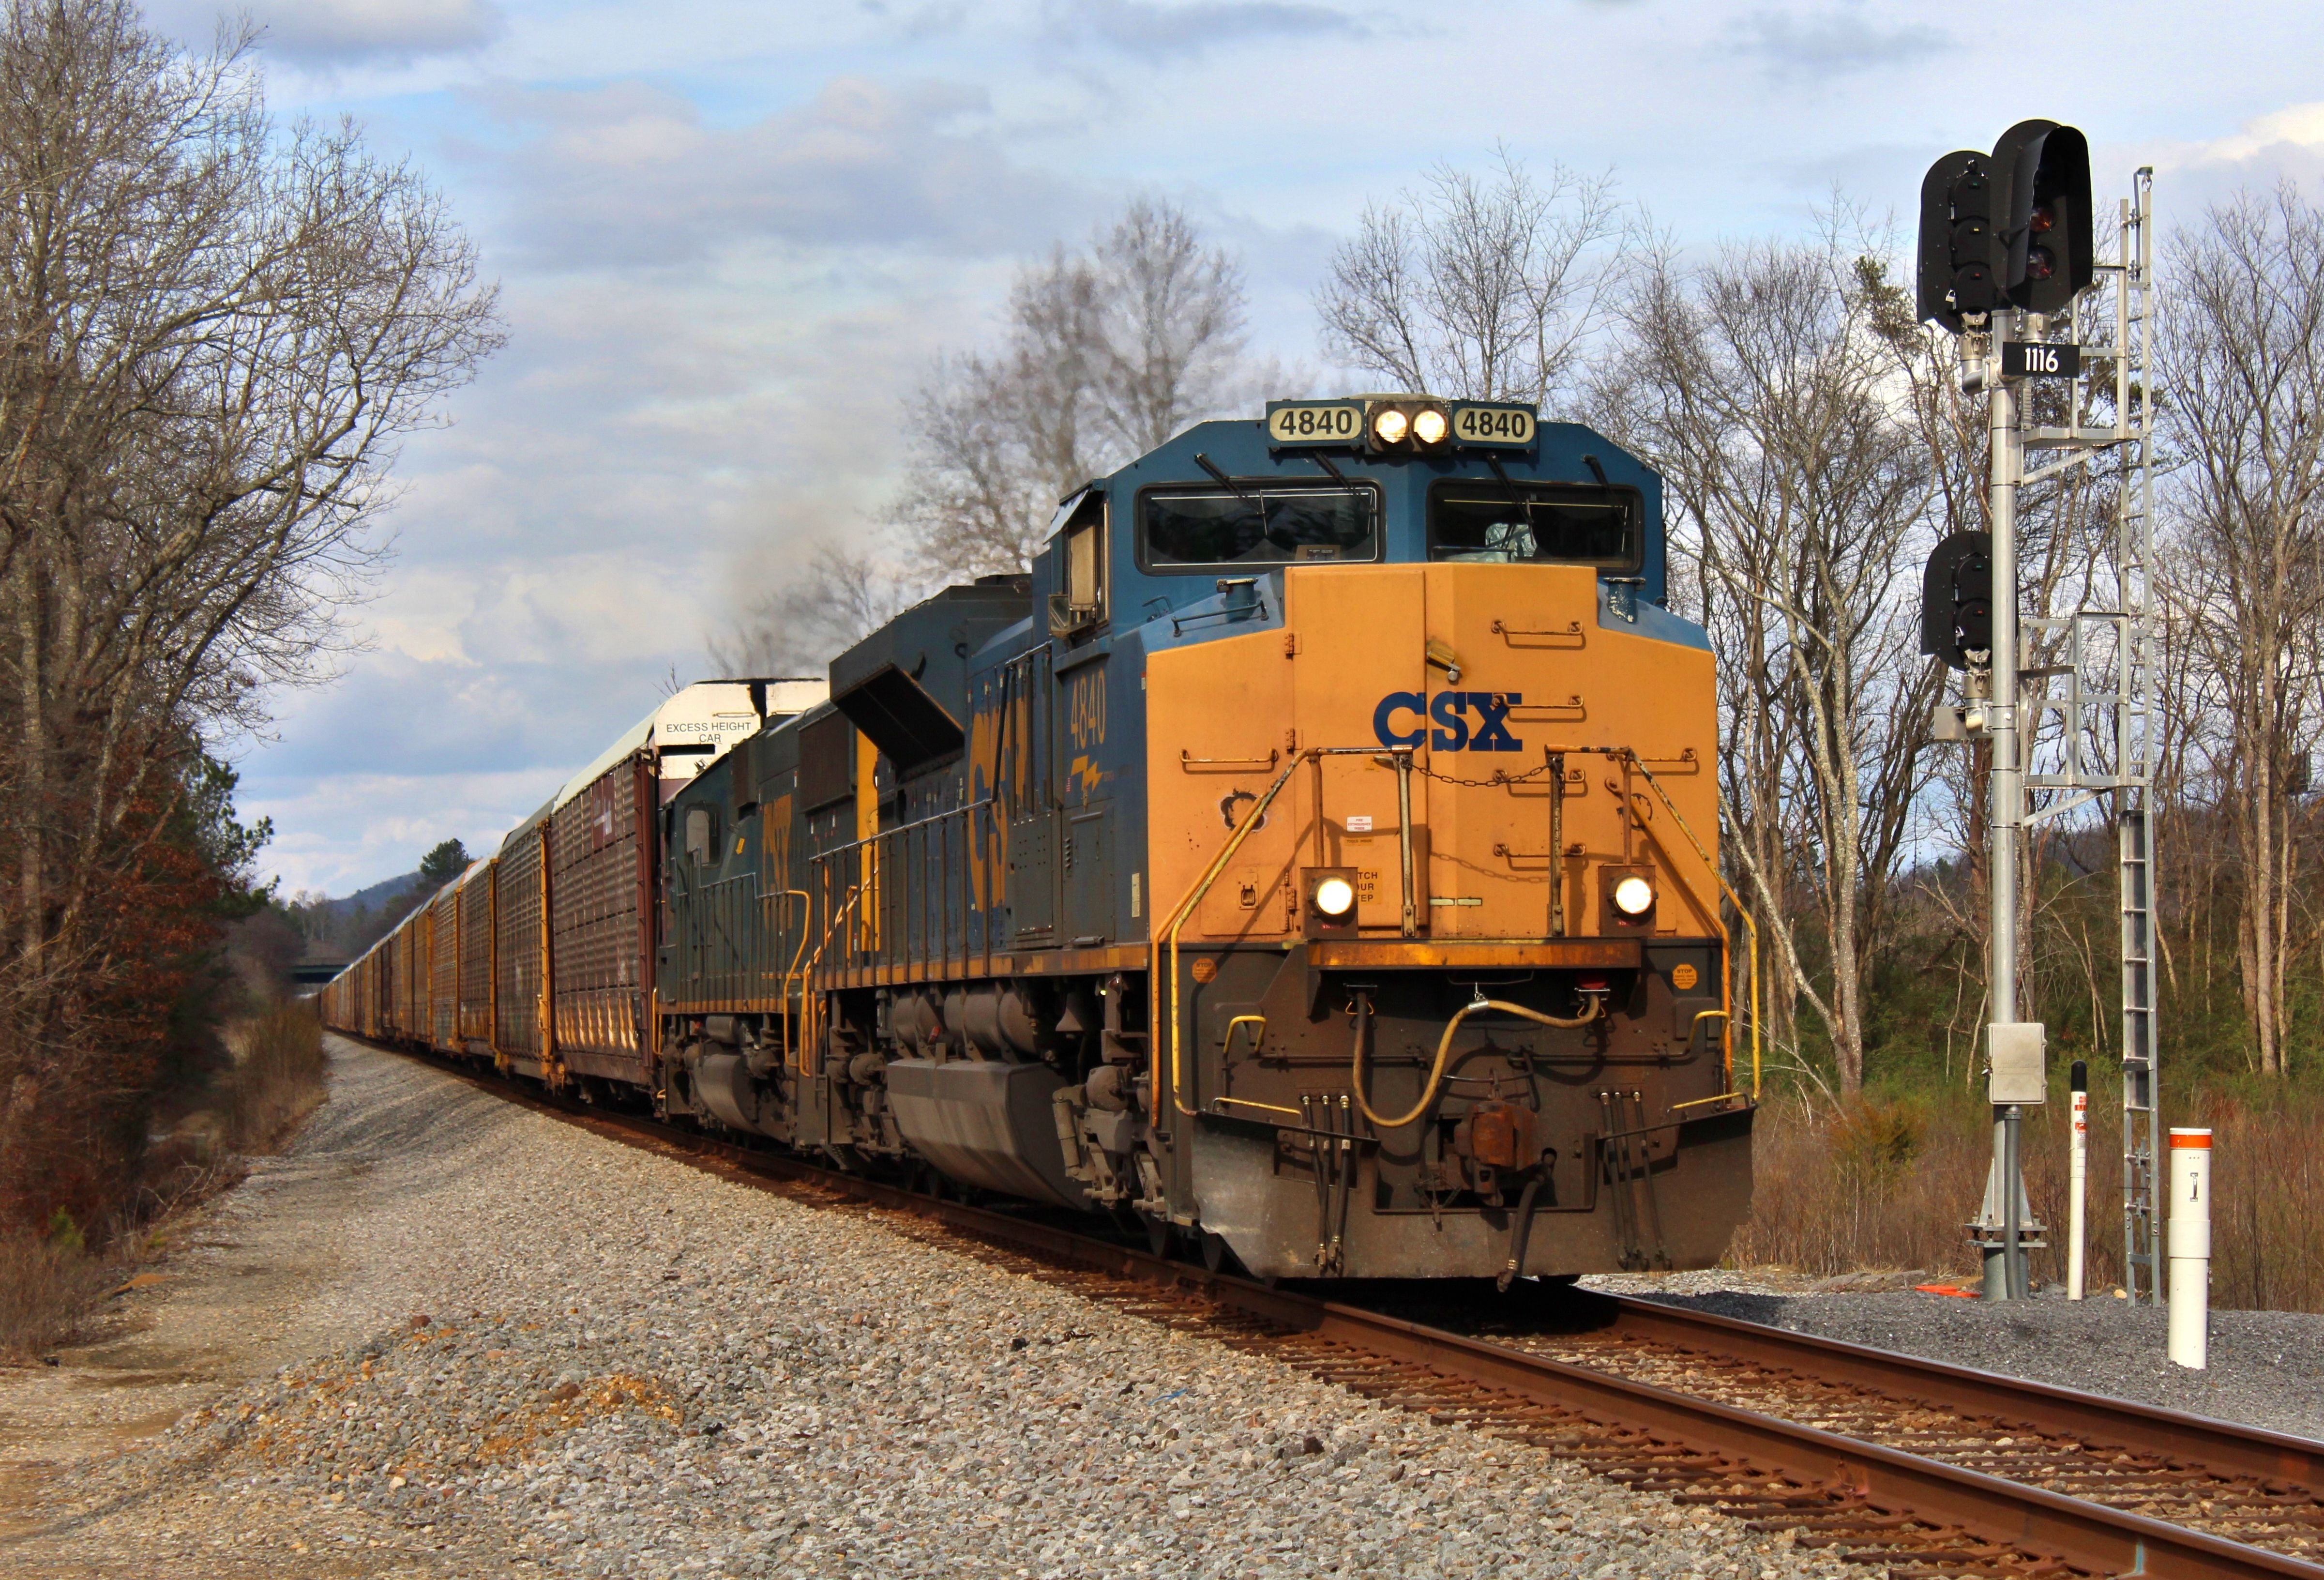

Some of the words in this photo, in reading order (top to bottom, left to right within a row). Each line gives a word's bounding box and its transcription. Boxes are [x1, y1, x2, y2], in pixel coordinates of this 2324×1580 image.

[2025, 347, 2059, 372] 1116
[1279, 410, 1353, 436] 4840
[1462, 411, 1526, 438] 4840
[1071, 668, 1106, 750] 4840
[1373, 691, 1523, 752] CSX
[666, 722, 709, 732] EXCESS
[711, 722, 751, 731] HEIGHT
[699, 733, 722, 743] CAR
